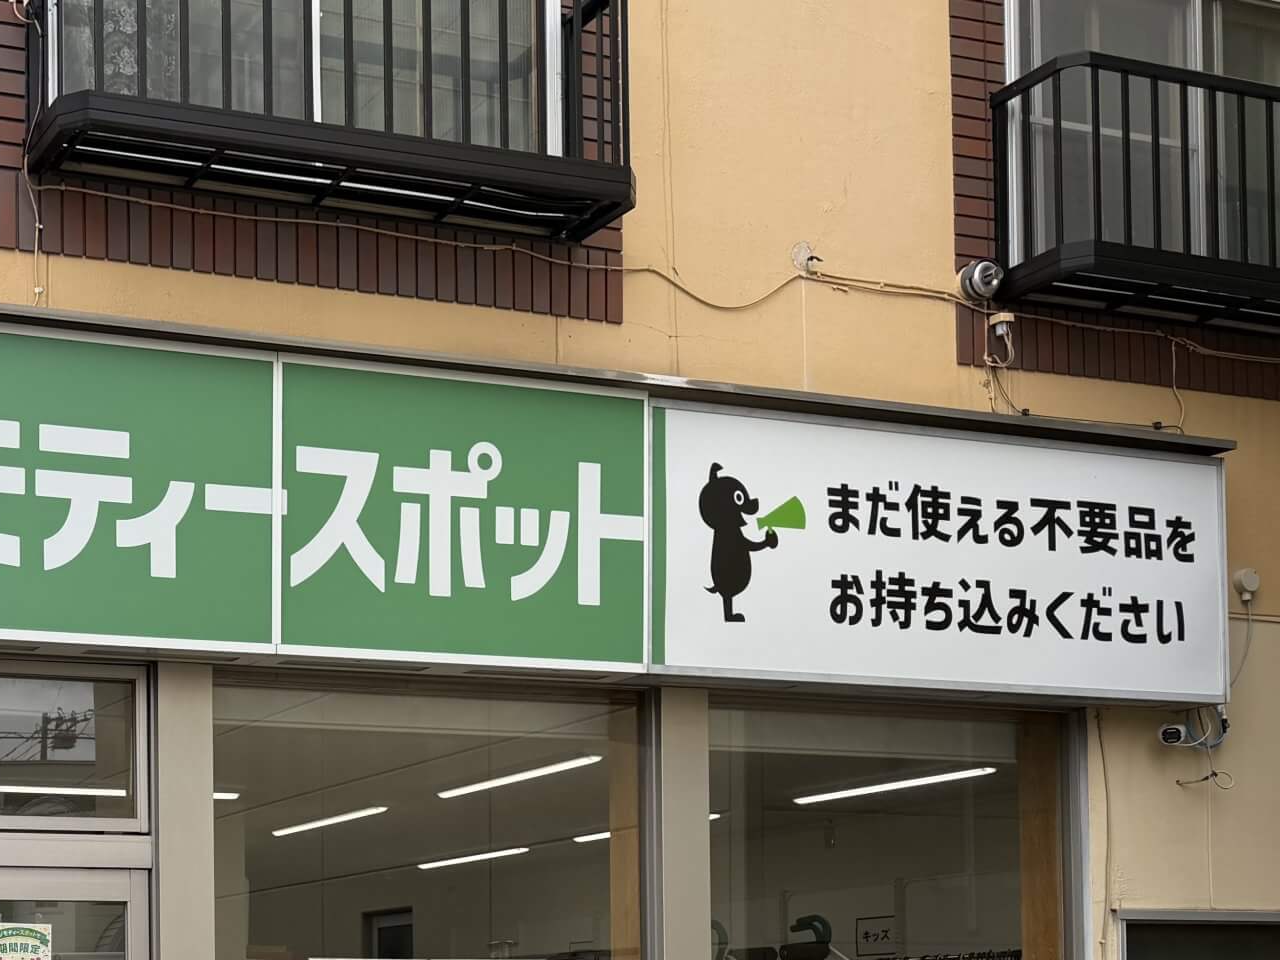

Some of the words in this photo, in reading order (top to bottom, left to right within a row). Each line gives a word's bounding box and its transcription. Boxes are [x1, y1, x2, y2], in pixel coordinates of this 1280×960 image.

[826, 481, 1196, 564] まだ使える不要品を
[829, 569, 1186, 645] お持ち込みください
[863, 928, 890, 942] キッズ
